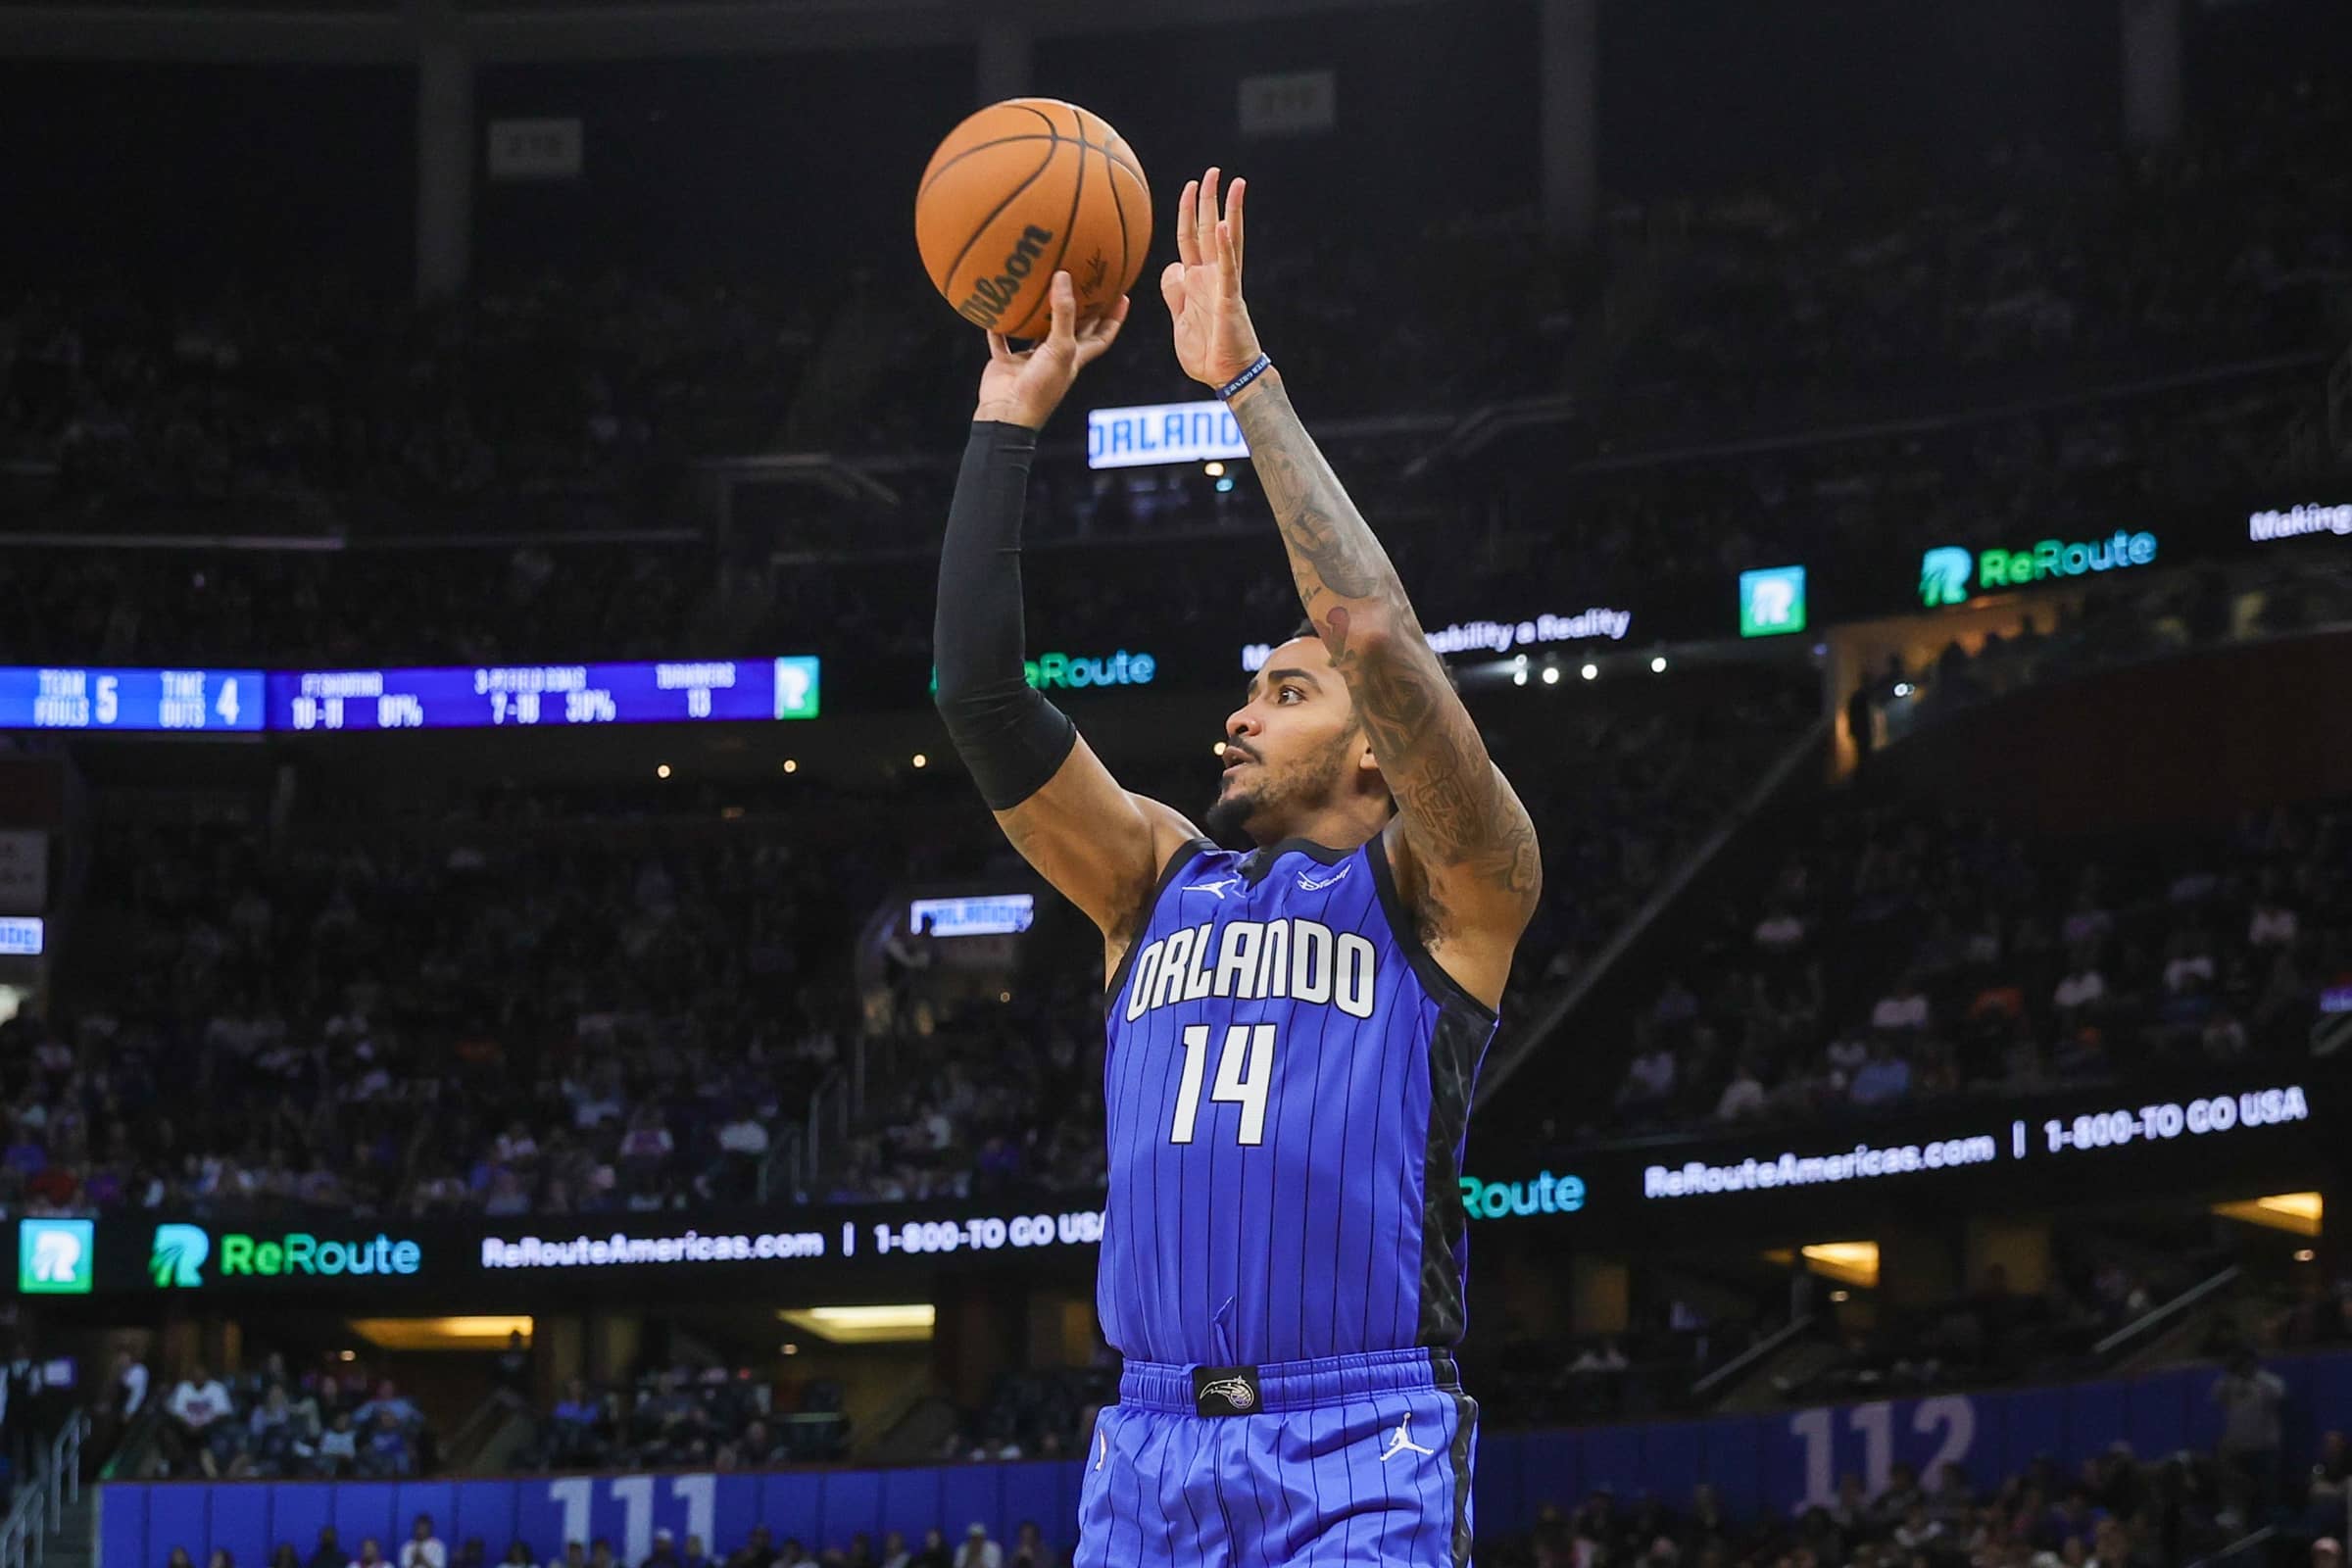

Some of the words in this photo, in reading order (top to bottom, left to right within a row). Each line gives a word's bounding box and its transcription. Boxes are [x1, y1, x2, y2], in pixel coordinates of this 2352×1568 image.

[959, 224, 1053, 328] Wilson
[1089, 412, 1243, 460] ORLAND
[1981, 531, 2156, 587] ReRoute
[1538, 609, 1631, 641] Reality
[1025, 651, 1155, 693] eRoute
[98, 677, 117, 722] 5
[218, 680, 238, 723] 4
[1125, 917, 1377, 1023] ORLANDO
[1169, 1023, 1278, 1146] 14
[1644, 1136, 1995, 1198] ReRouteAmericas.com
[2044, 1103, 2184, 1152] 1-800-TO
[2186, 1097, 2237, 1133] GO
[2239, 1087, 2308, 1126] USA
[1459, 1168, 1585, 1218] Route
[221, 1234, 420, 1274] ReRoute
[482, 1230, 825, 1267] ReRouteAmericas.com
[874, 1218, 1006, 1253] 1-800-TO
[1008, 1214, 1055, 1247] GO
[1790, 1393, 1975, 1517] 112
[550, 1473, 716, 1568] 111
